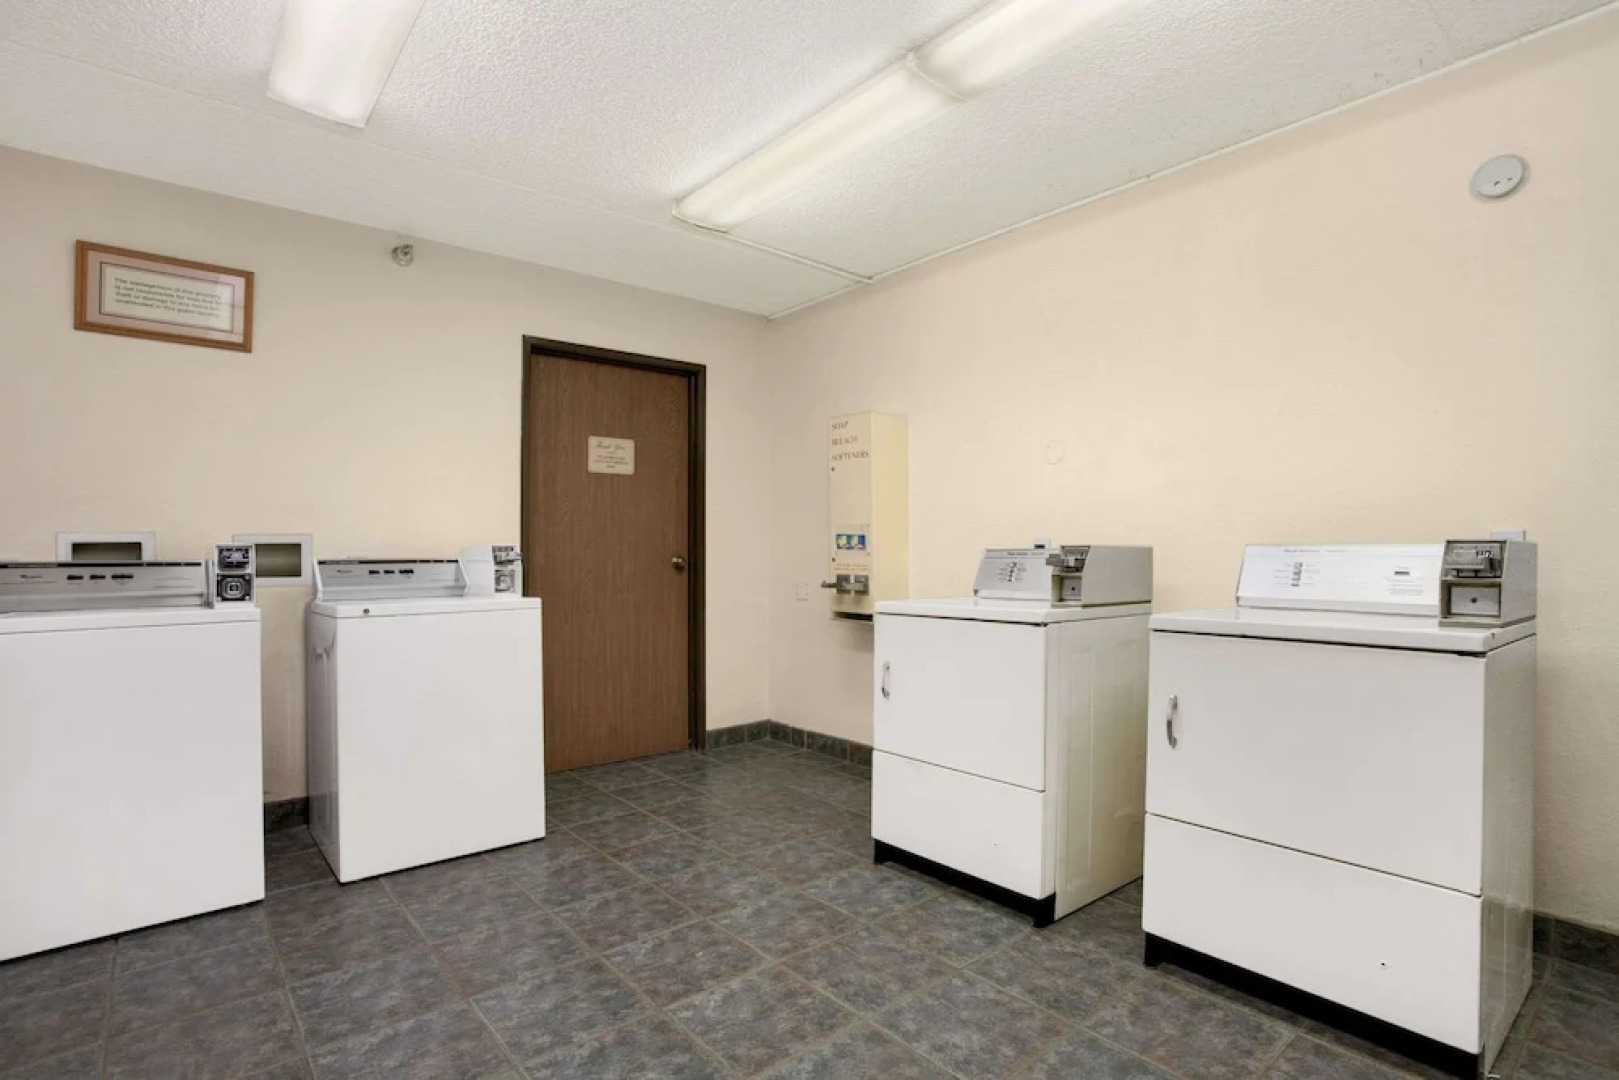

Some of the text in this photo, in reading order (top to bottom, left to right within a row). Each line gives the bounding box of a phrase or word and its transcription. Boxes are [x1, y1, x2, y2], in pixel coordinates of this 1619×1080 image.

[831, 420, 849, 430] SOAP
[831, 435, 859, 445] BLEACH
[831, 449, 869, 460] SOFTENERS
